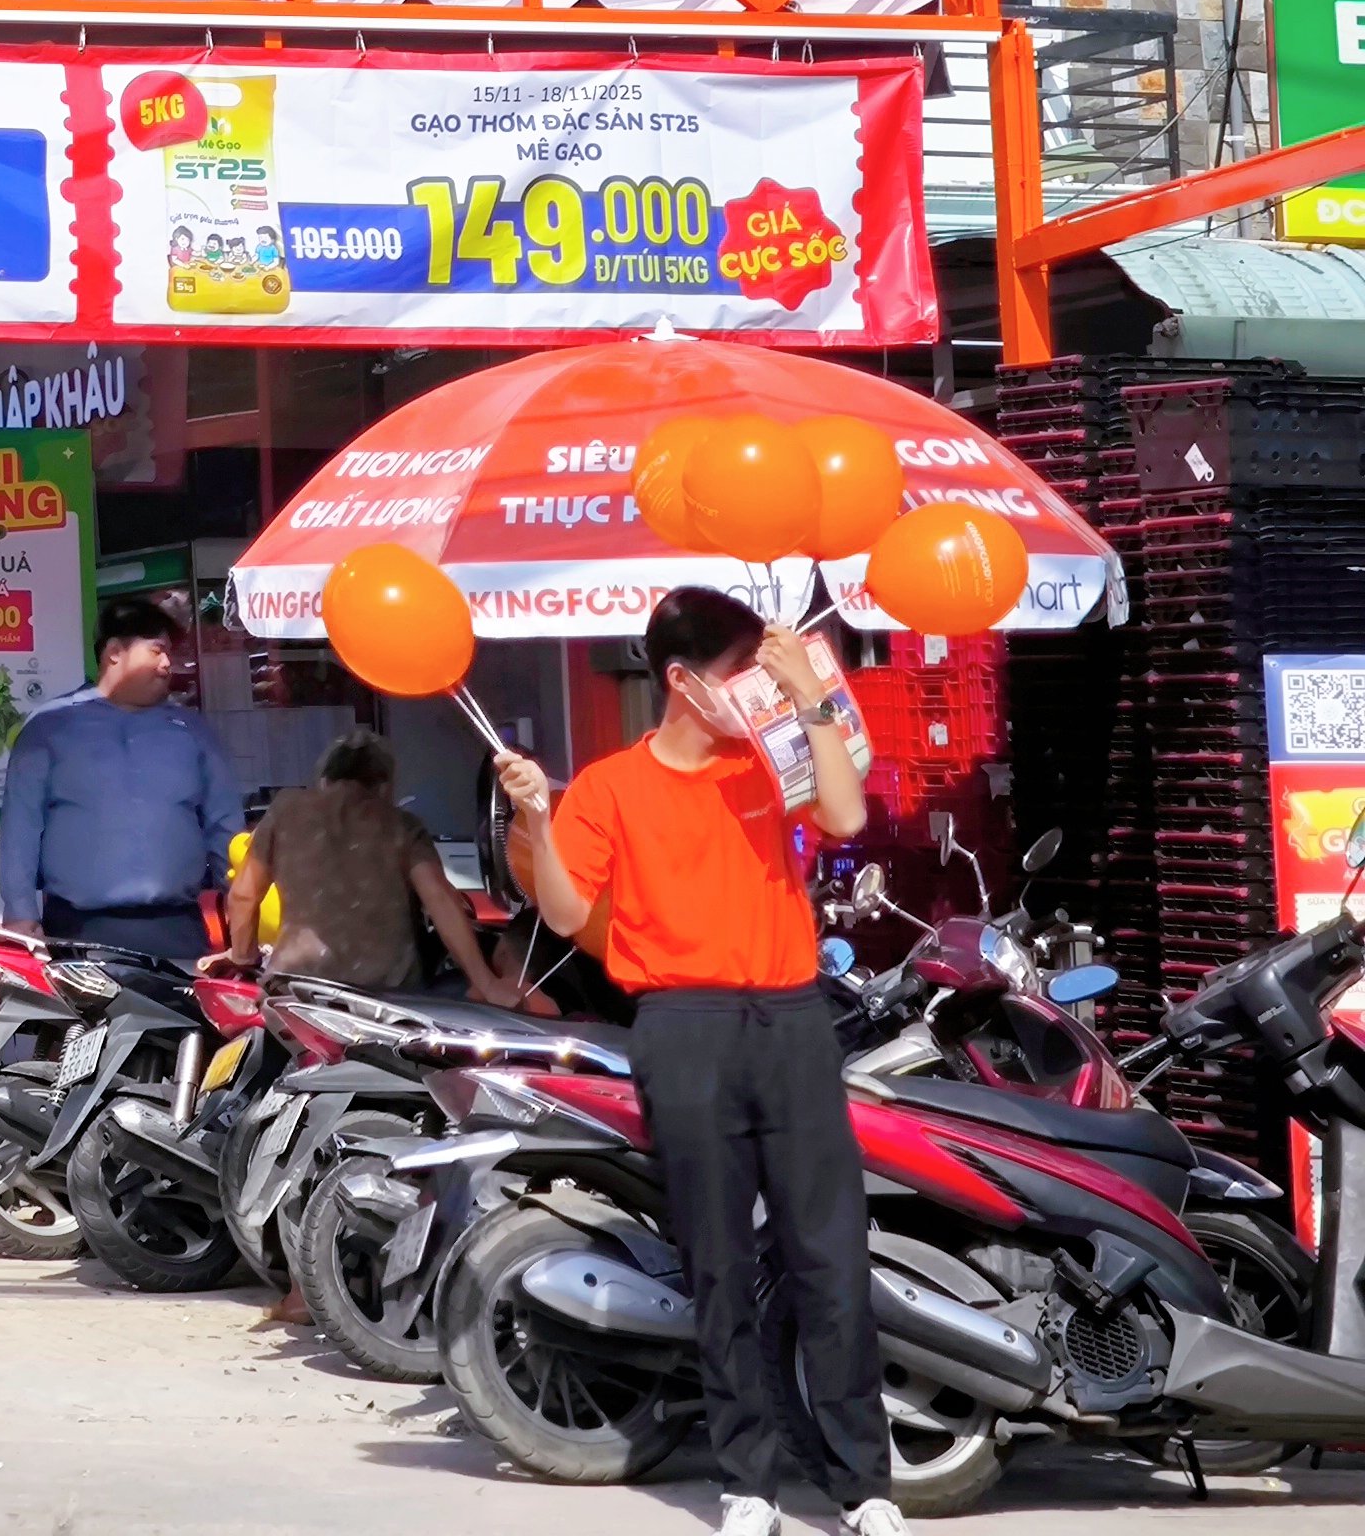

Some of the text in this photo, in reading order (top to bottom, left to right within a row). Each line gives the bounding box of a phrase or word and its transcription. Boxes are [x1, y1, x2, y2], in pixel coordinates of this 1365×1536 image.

[139, 92, 187, 127] 5KG
[472, 82, 644, 104] 15/11 18/11/2025
[410, 106, 700, 139] GẠO THƠM ĐẶC SẢN ST25
[174, 157, 267, 181] ST25
[516, 136, 604, 167] MÊ GẠO
[289, 178, 710, 287] 195.000 149.000
[745, 200, 803, 239] GIÁ
[594, 248, 711, 285] Đ/TÚI 5KG
[718, 228, 849, 284] CỰC SỐC
[407, 443, 493, 477] NGON
[546, 439, 637, 474] SIÊU
[289, 489, 361, 530] CHẤT
[499, 493, 612, 530] THỰC
